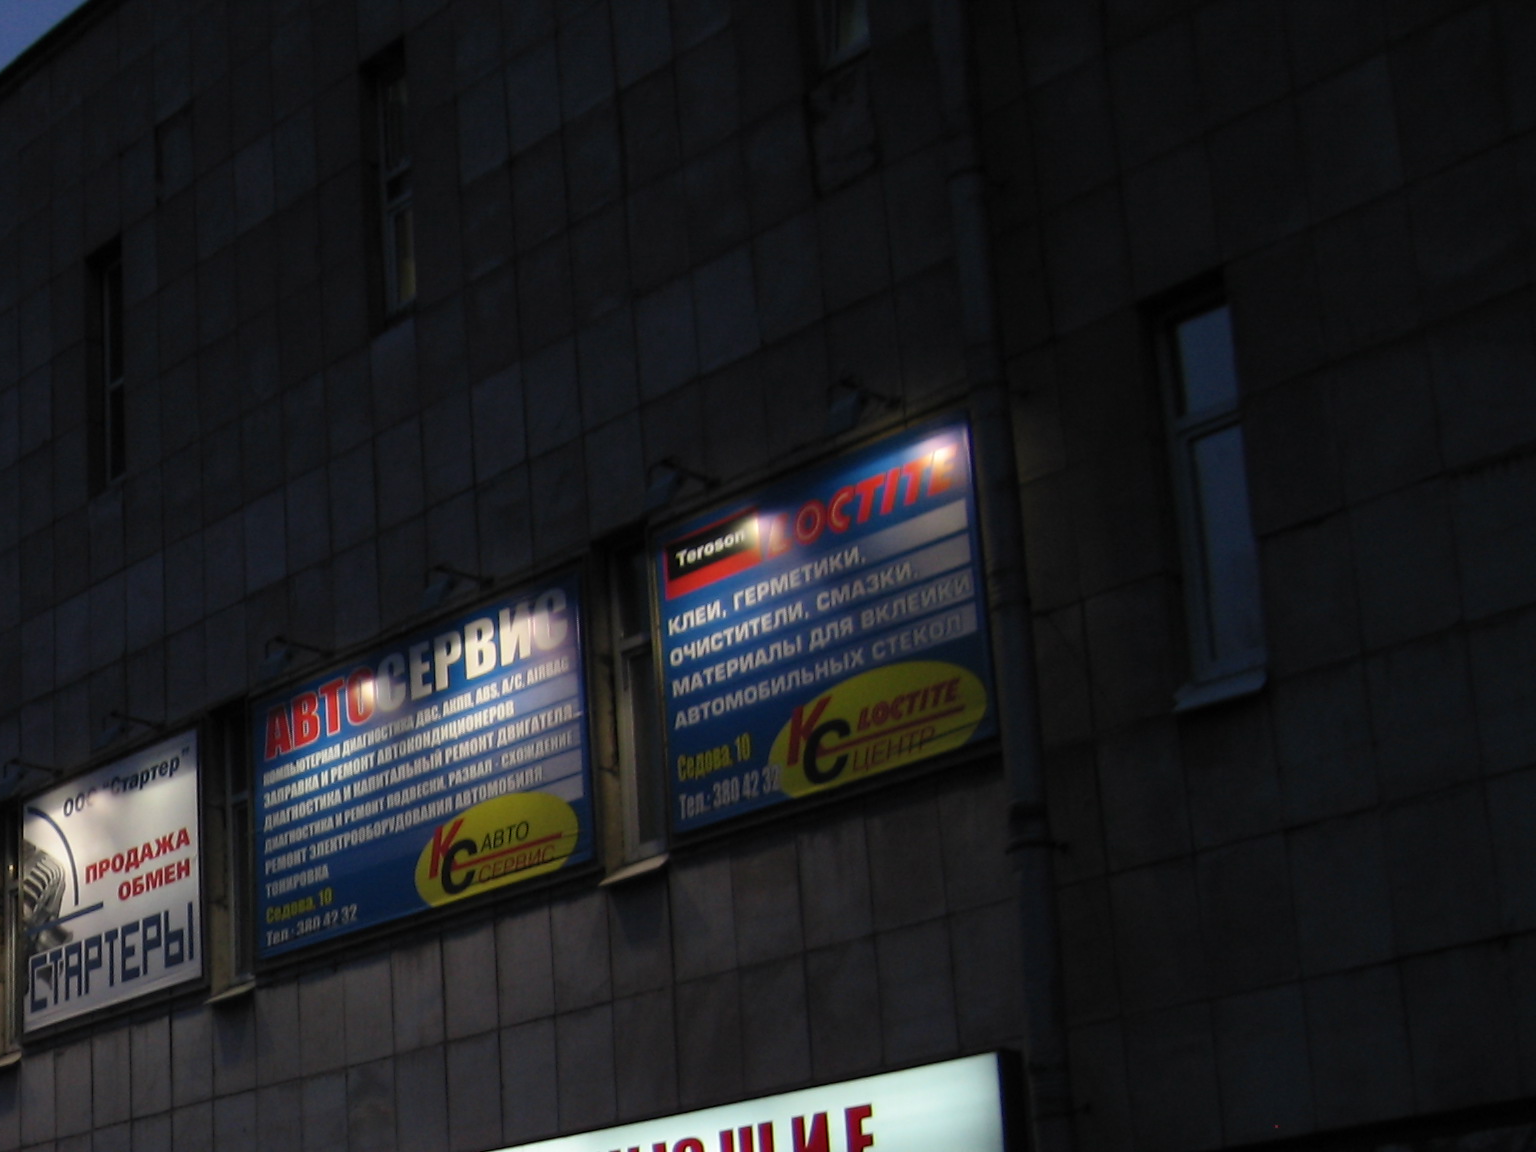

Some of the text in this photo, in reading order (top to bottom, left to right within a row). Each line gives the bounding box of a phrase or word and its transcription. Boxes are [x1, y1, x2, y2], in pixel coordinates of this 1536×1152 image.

[767, 443, 959, 560] LOCTITE
[675, 529, 745, 567] Teroson
[733, 547, 866, 611] ГЕРМЕТИКИ,
[670, 561, 919, 666] ОЧИСТИТЕЛИ, СМАЗКИ,
[265, 587, 567, 760] АВТОСЕРВИС
[672, 635, 803, 697] МАТЕРИАЛЫ
[809, 616, 854, 651] ДЛЯ
[675, 613, 962, 730] АВТОМОБИЛЬНЫХ СТЕКОЛ
[857, 677, 961, 731] LOCTITE
[264, 700, 514, 808] ЗАПРАВКА И РЕМОНТ АВТОКОНДИЦИОНЕРОВ
[342, 716, 414, 759] ДИАГНОСТИКА
[735, 732, 751, 762] 10
[852, 725, 936, 773] ЦЕНТР
[264, 793, 341, 832] ДИАГНОСТИКА
[343, 785, 351, 802] И
[354, 750, 442, 798] КАПИТАЛЬНЫЙ
[445, 735, 493, 765] РЕМОНТ
[264, 815, 333, 855] ДИАГНОСТИКА
[344, 800, 385, 826] РЕМОНТ
[449, 758, 492, 787] РАЗВАЛ
[713, 776, 740, 808] 380
[742, 769, 759, 799] 42
[265, 766, 543, 876] РЕМОНТ ЭЛЕКТРООБОРУДОВАНИЯ АВТОМОБИЛЯ
[480, 821, 530, 852] АВТО
[85, 827, 191, 885] ПРОДАЖА
[117, 858, 191, 901] ОБМЕН
[266, 864, 329, 898] ТОНИРОВКА
[478, 845, 556, 884] СЕРВИС
[318, 887, 333, 906] 10
[340, 903, 358, 923] 32
[30, 902, 195, 1014] СТАРТЕРЫ
